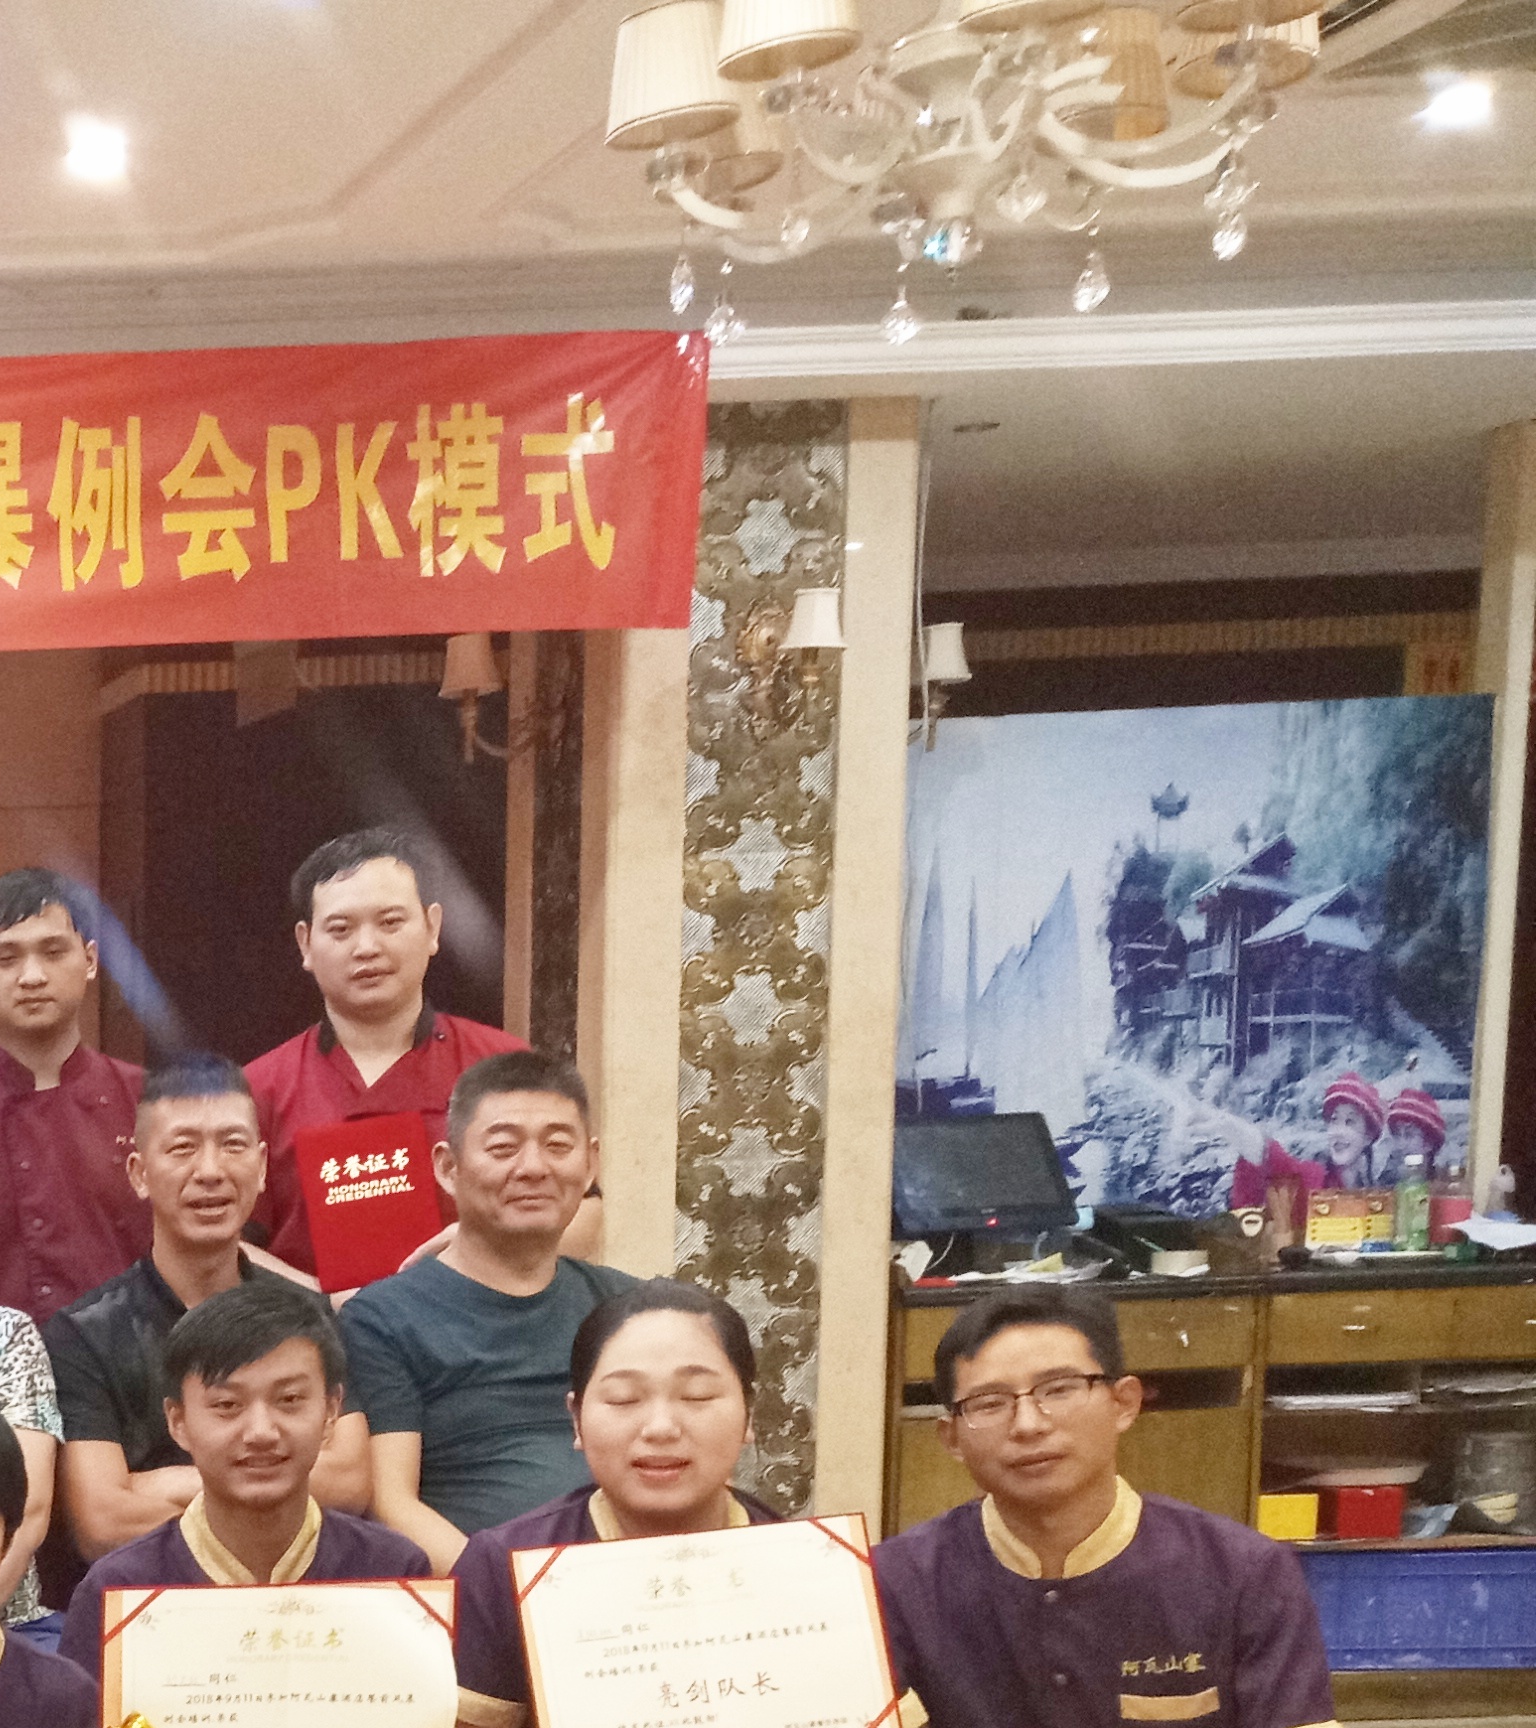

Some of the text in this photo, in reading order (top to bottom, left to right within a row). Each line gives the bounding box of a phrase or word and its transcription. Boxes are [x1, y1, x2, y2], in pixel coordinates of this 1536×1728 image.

[320, 1148, 410, 1183] 荣誉证书
[325, 1182, 415, 1205] CREDENTIAL
[328, 1175, 408, 1195] HONORARY
[239, 1627, 345, 1652] 荣誉证书
[658, 1671, 781, 1709] 亮剑队长
